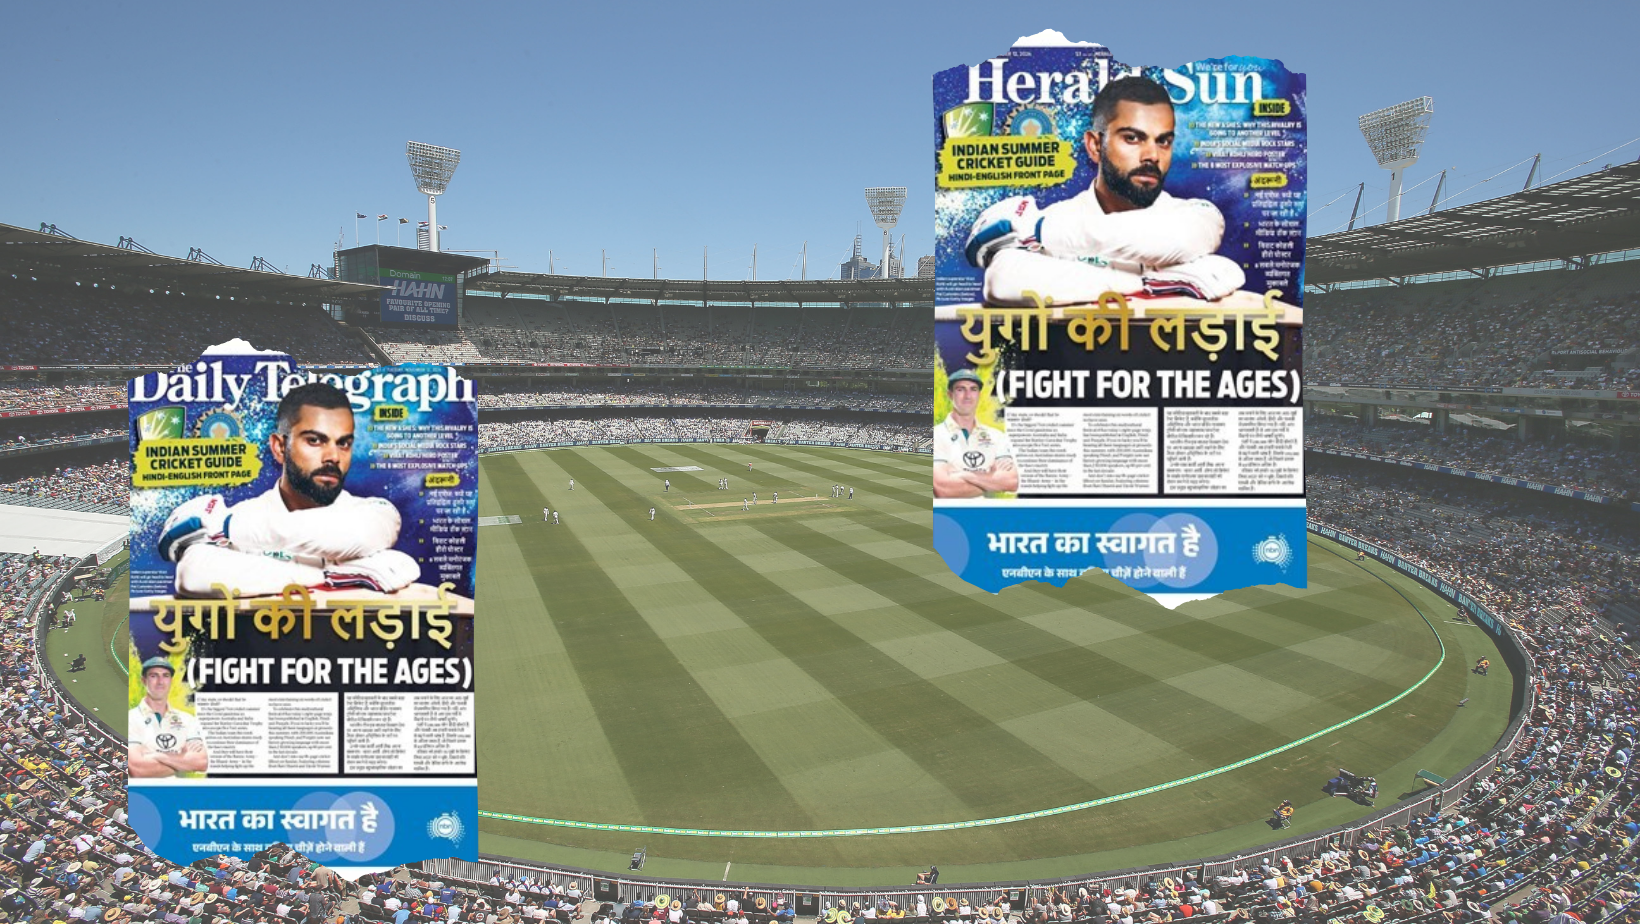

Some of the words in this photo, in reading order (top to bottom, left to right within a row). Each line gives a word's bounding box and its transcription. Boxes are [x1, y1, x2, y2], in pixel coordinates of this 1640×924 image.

[964, 58, 1141, 104] Heral
[1164, 62, 1262, 104] Sun
[1259, 103, 1286, 113] INSIDE
[952, 144, 999, 156] INDIAN
[1002, 142, 1059, 155] SUMMER
[957, 157, 1013, 170] CRICKET
[1015, 155, 1055, 167] GUIDE
[948, 172, 1012, 181] HINDI-ENGLISH
[1014, 171, 1042, 179] FRONT
[1043, 170, 1065, 178] PAGE
[1391, 172, 1395, 180] 1
[390, 270, 420, 279] Domain
[392, 280, 445, 299] HAHN
[387, 299, 422, 307] FAVOURITE
[404, 314, 435, 322] DISCUSS
[957, 290, 1054, 365] युगों
[1064, 290, 1135, 351] की
[1145, 289, 1285, 362] लड़ाई
[130, 361, 252, 411] Daily
[996, 370, 1090, 404] (FIGHT
[1097, 370, 1150, 398] FOR
[1157, 370, 1212, 398] THE
[1217, 370, 1300, 404] AGES)
[379, 408, 403, 418] INSIDE
[146, 446, 190, 458] INDIAN
[192, 444, 246, 456] SUMMER
[151, 458, 202, 470] CRICKET
[205, 456, 242, 467] GUIDE
[142, 472, 201, 481] HINDI-ENGLISH
[204, 471, 230, 479] FRONT
[231, 470, 251, 478] PAGE
[1451, 468, 1466, 476] HAHN
[1501, 477, 1518, 485] HAHN
[1526, 482, 1544, 491] HAHN
[1554, 488, 1574, 497] HAHN
[1584, 493, 1603, 503] HAHN
[987, 532, 1049, 555] भारत
[1054, 532, 1089, 555] का
[1096, 532, 1176, 556] स्वागत
[1182, 523, 1200, 557] है
[1338, 533, 1357, 547] BANTER
[1358, 542, 1378, 556] BREAKS
[1398, 560, 1418, 575] BANTER
[1418, 571, 1438, 587] BREAKS
[150, 583, 241, 653] युगों
[251, 583, 317, 640] की
[326, 582, 458, 650] लड़ाई
[187, 657, 275, 689] (FIGHT
[281, 658, 331, 684] FOR
[337, 658, 389, 684] THE
[394, 657, 472, 689] AGES)
[178, 809, 236, 831] भारत
[242, 809, 274, 831] का
[280, 809, 355, 831] स्वागत
[361, 801, 378, 832] है
